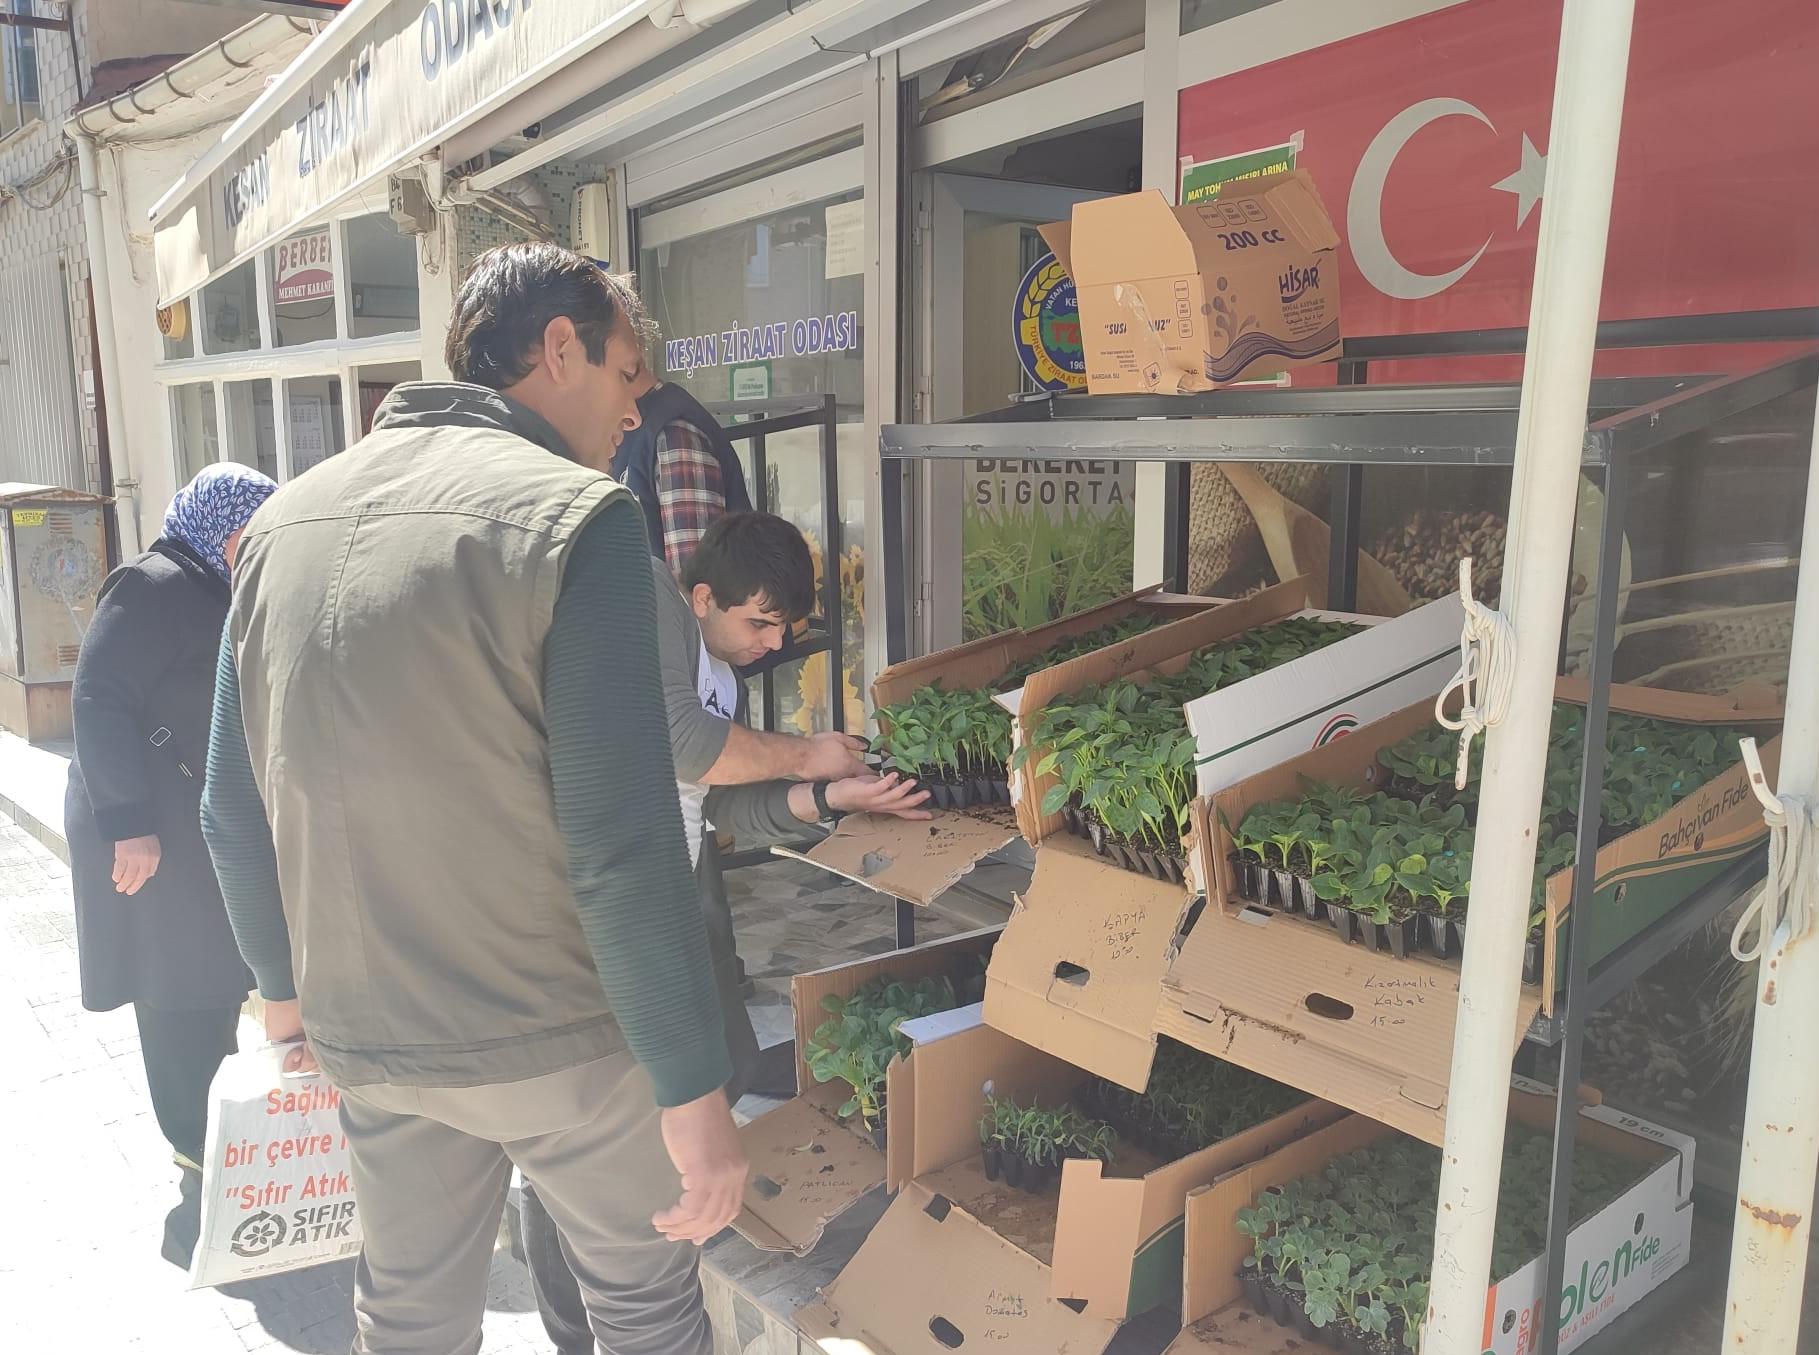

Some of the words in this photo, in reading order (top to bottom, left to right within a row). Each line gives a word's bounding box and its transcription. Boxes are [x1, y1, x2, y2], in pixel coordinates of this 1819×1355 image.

[1187, 187, 1203, 201] MAY
[1217, 230, 1259, 251] 200
[279, 285, 306, 299] MEHMET
[1279, 264, 1320, 295] HİSAR
[1045, 287, 1063, 310] VATAN
[1065, 297, 1078, 308] KE
[666, 333, 718, 379] KEŞAN
[721, 320, 788, 365] ZİRAAT
[792, 310, 857, 357] ODASI
[1051, 322, 1081, 344] TZ
[1721, 777, 1749, 814] Fide
[266, 1084, 340, 1117] Sağlık
[1617, 1116, 1639, 1128] 19
[1639, 1125, 1665, 1139] cm
[224, 1138, 259, 1168] bir
[266, 1133, 333, 1168] çevre
[293, 1200, 356, 1228] SIFIR
[288, 1219, 353, 1247] ATIK
[1557, 1239, 1632, 1330] olen
[1631, 1234, 1660, 1273] Fide
